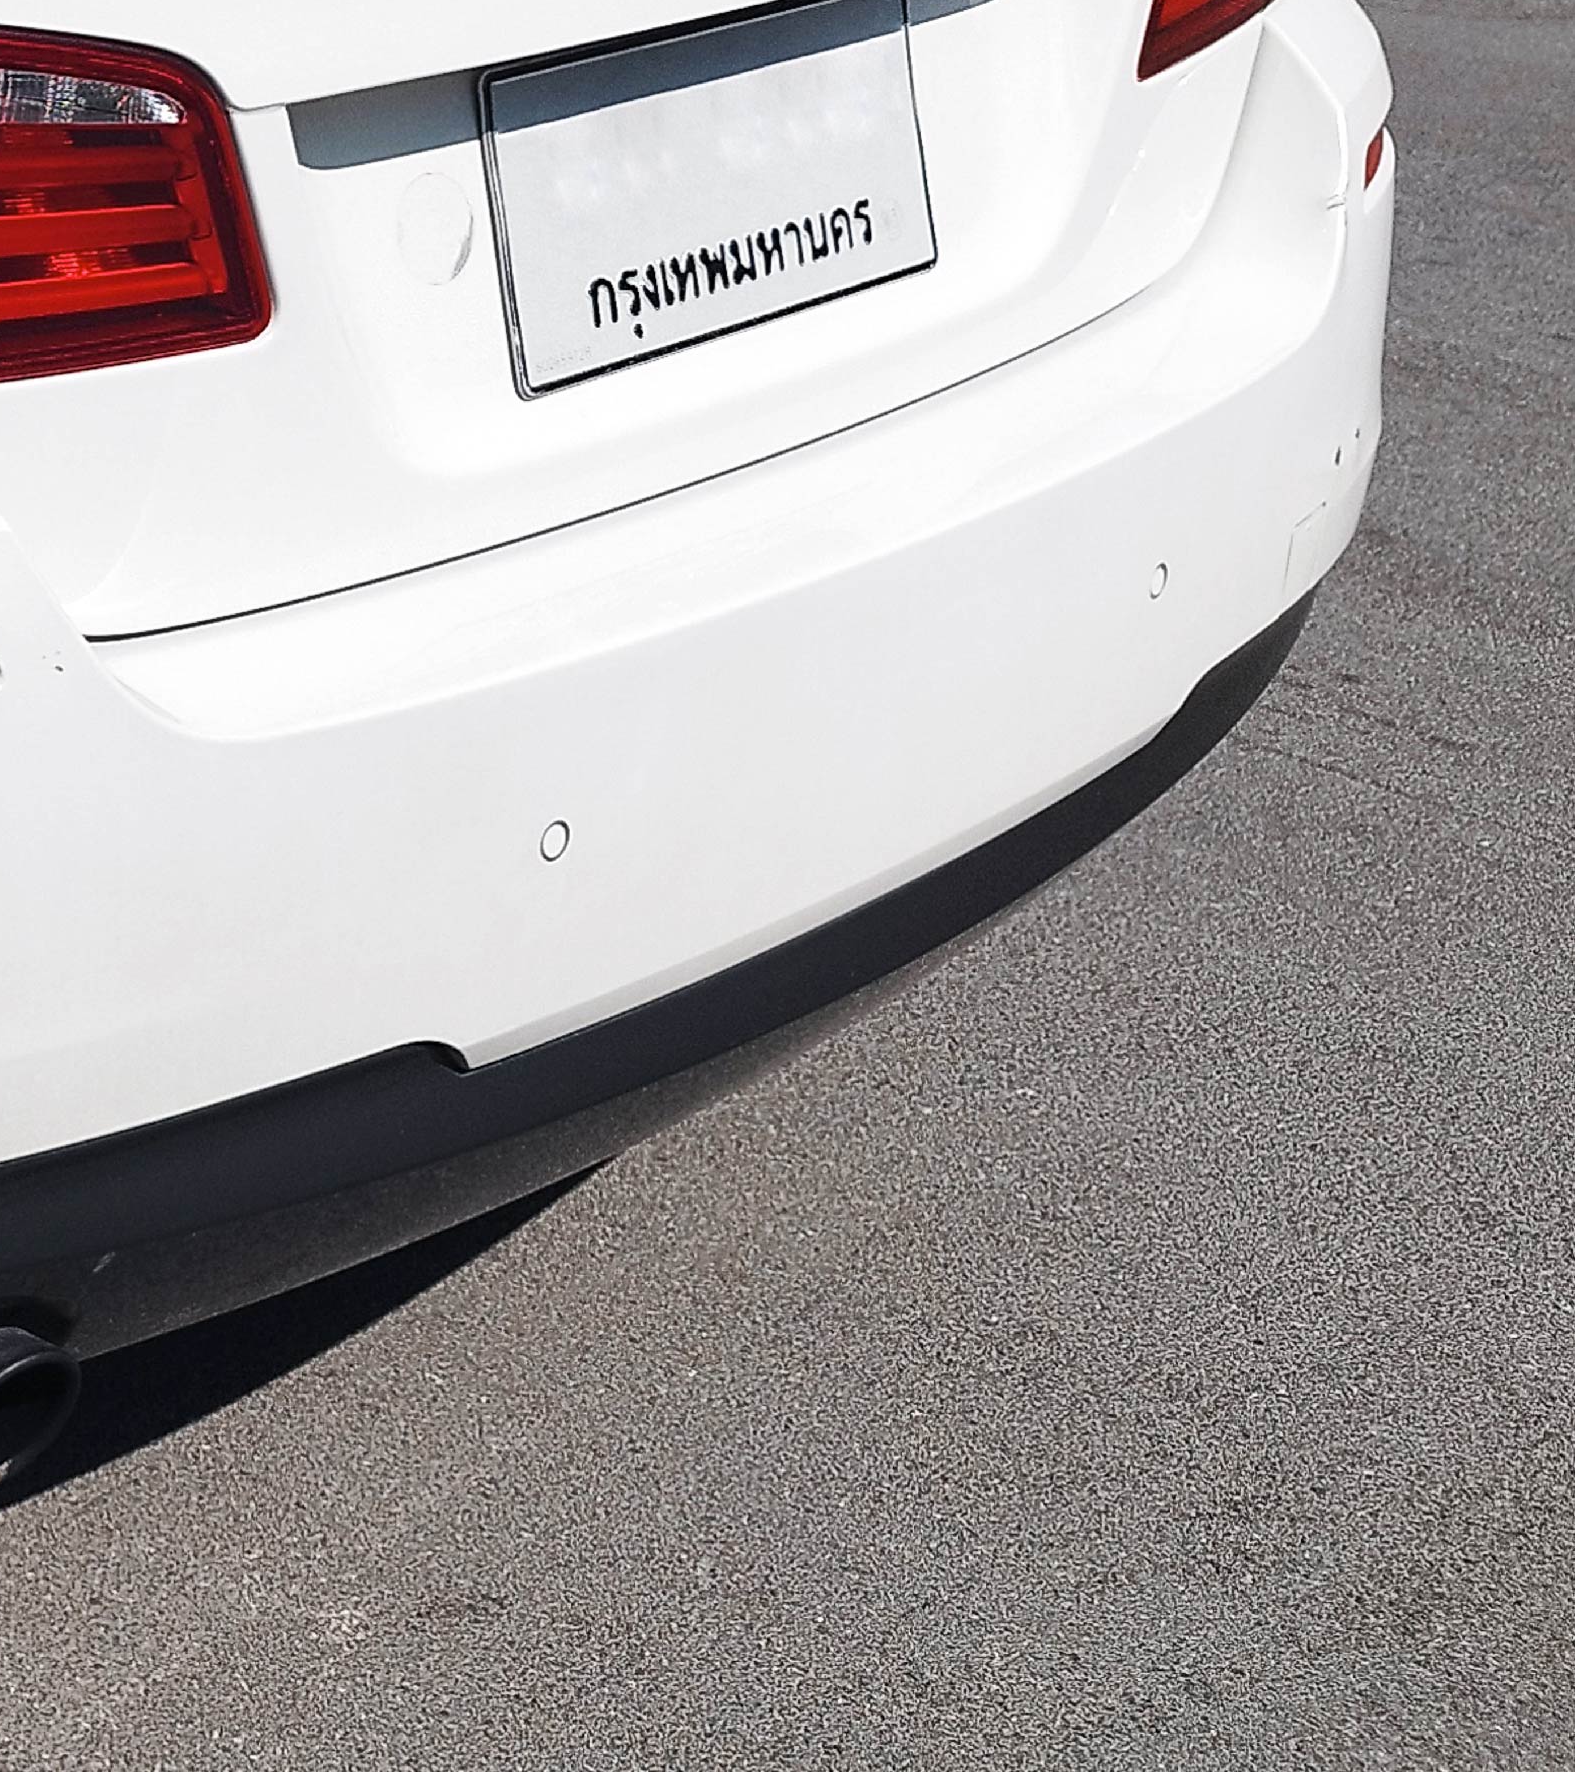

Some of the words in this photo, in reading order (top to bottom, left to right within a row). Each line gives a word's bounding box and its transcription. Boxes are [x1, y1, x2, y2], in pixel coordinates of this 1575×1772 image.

[587, 198, 872, 340] กรุงเทพมหานคร
